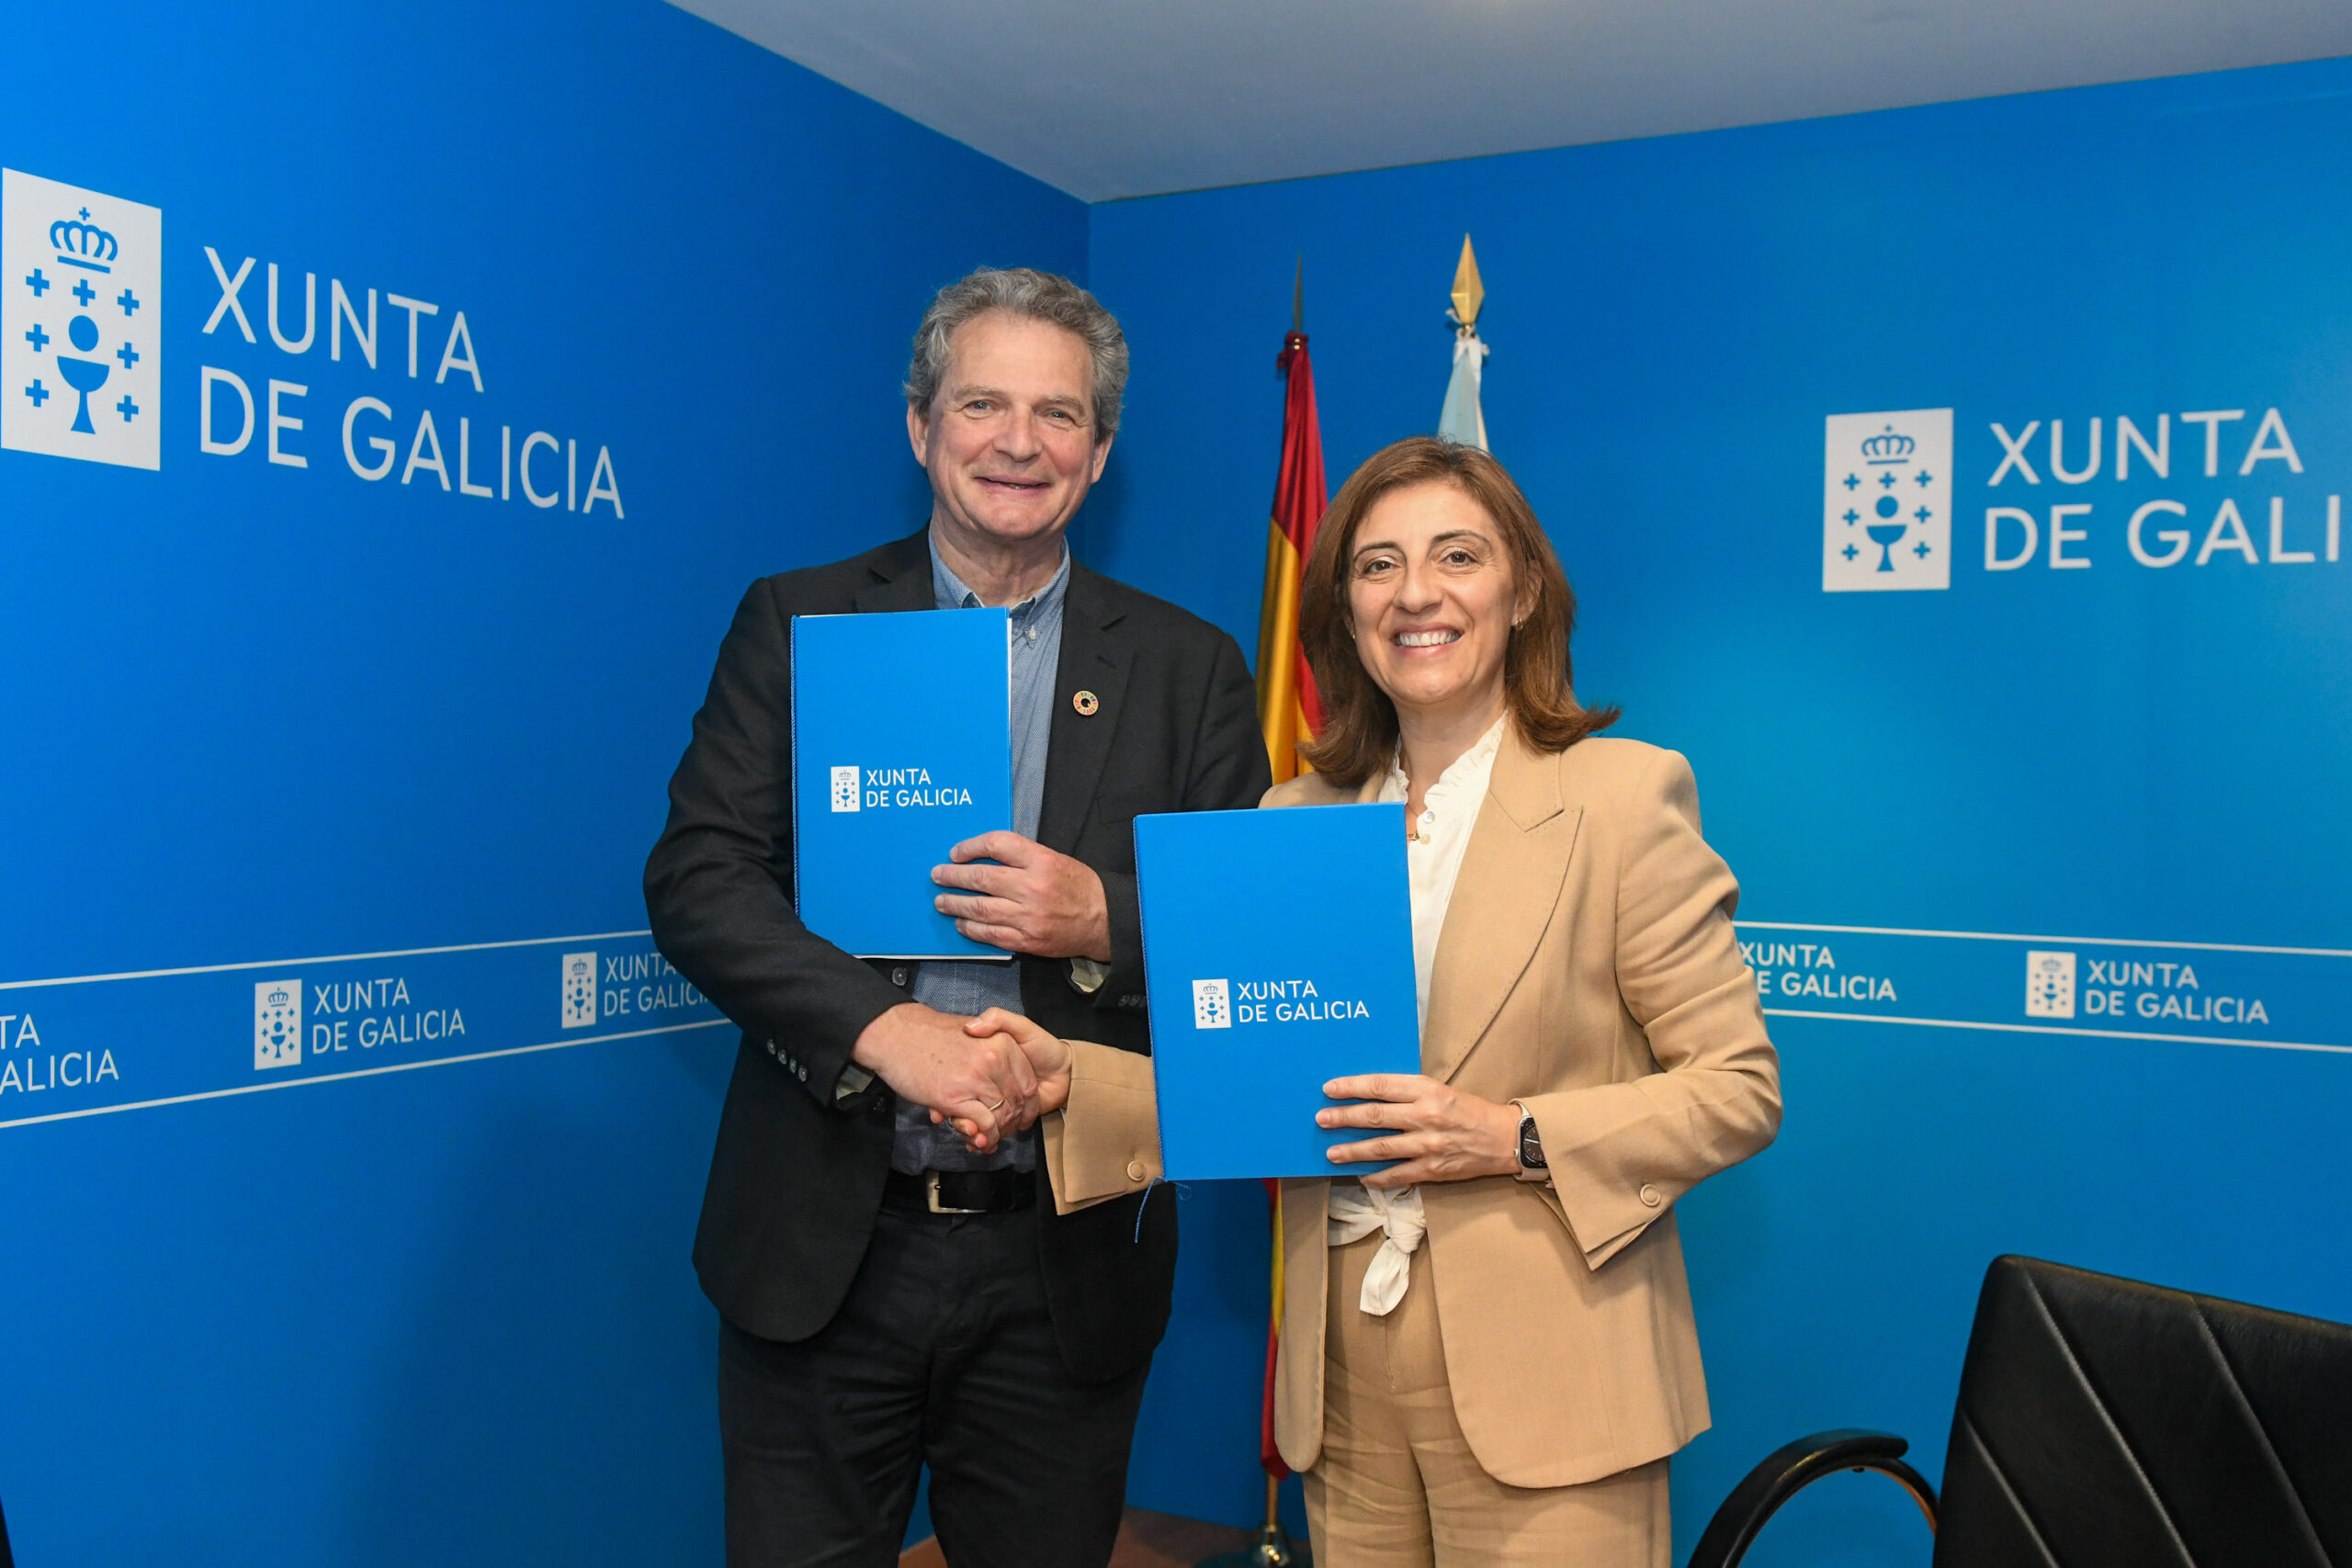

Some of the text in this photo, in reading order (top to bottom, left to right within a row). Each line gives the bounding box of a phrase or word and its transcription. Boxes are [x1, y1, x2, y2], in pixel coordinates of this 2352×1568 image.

[201, 246, 483, 393] XUNTA
[200, 366, 624, 520] DE GALICIA
[1988, 408, 2304, 486] XUNTA
[1984, 494, 2342, 570] DE GALI
[866, 768, 932, 787] XUNTA
[865, 788, 973, 808] DE GALICIA
[1738, 942, 1836, 969] XUNTA
[1237, 979, 1318, 1001] XUNTA
[1757, 970, 1897, 1002] E GALICIA
[2086, 960, 2199, 988] XUNTA
[313, 978, 410, 1015] XUNTA
[604, 987, 630, 1017] DE
[1238, 1000, 1370, 1023] DE GALICIA
[2086, 989, 2268, 1024] DE GALICIA
[312, 1009, 465, 1055] DE GALICIA
